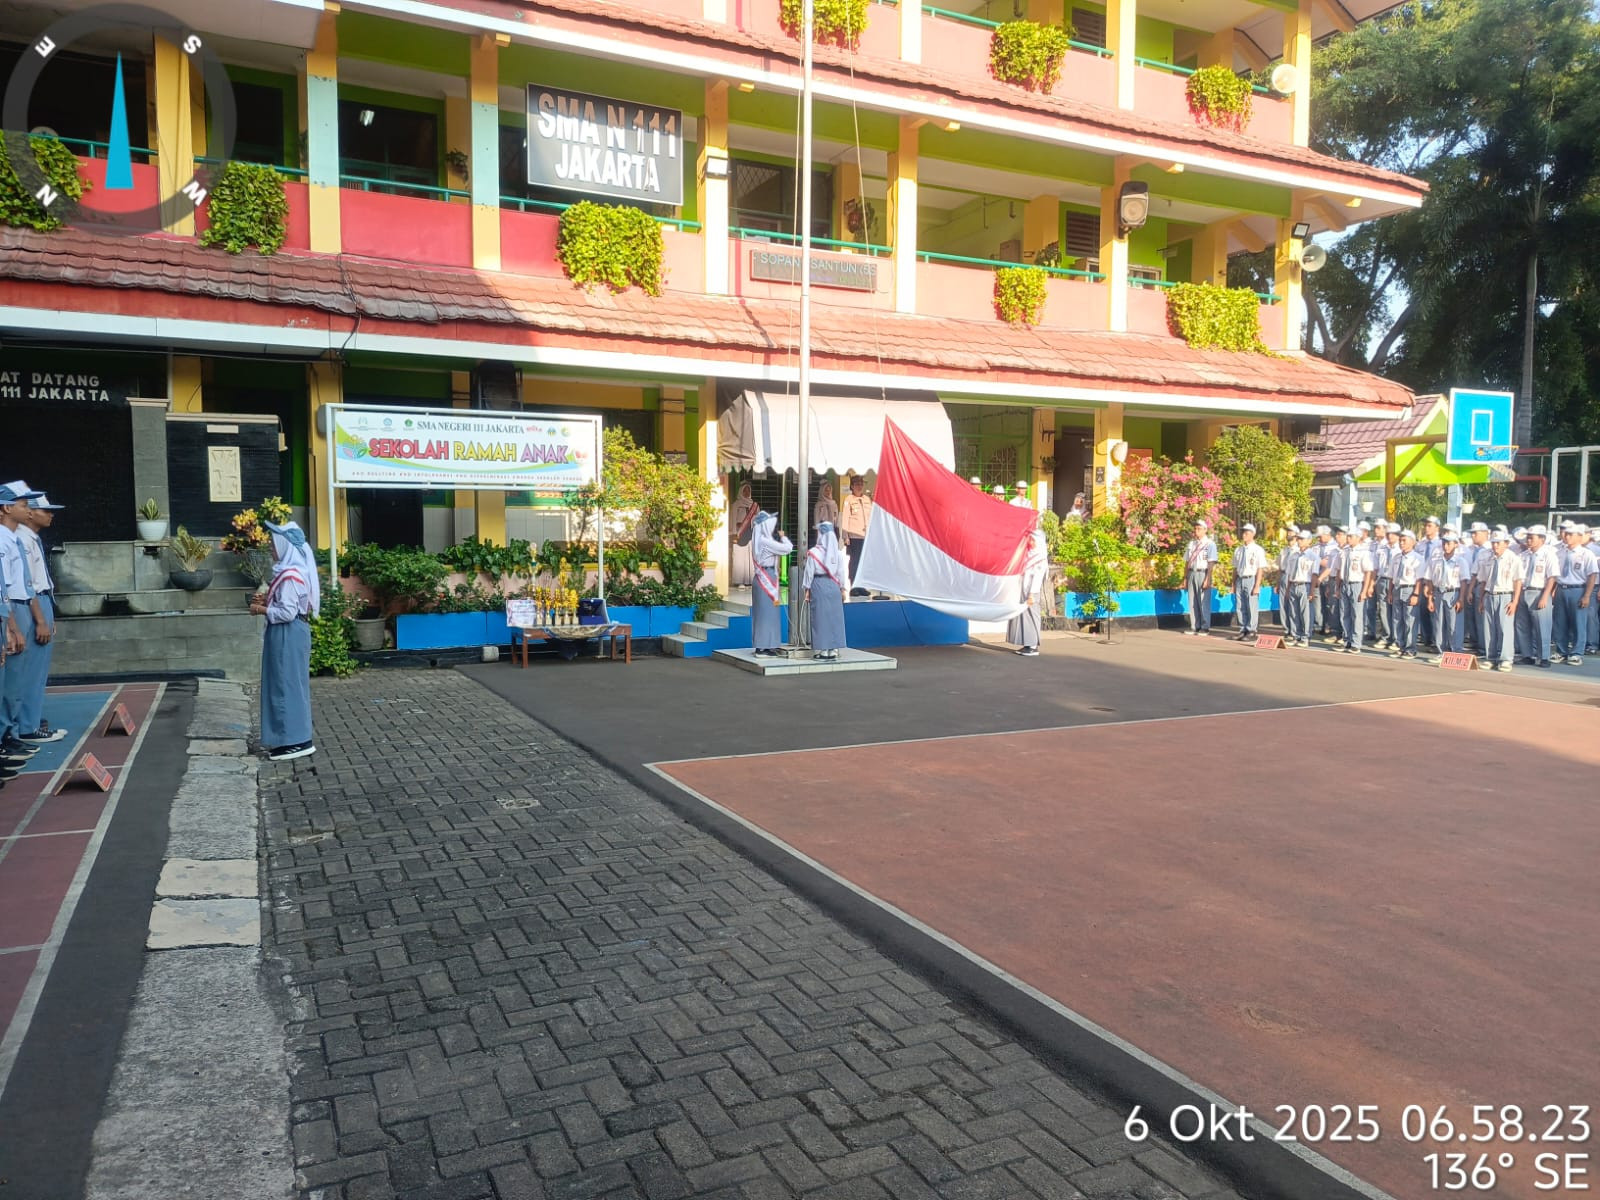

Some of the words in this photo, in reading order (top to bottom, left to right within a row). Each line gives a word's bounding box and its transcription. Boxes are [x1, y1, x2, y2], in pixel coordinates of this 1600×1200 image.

[538, 92, 600, 146] SMA
[607, 104, 627, 149] N
[632, 109, 676, 158] 111
[555, 143, 660, 193] JAKARTA
[760, 252, 801, 267] SOPAN
[811, 257, 857, 273] SANTUN
[31, 372, 100, 387] DATANG
[0, 385, 21, 398] 111
[28, 386, 110, 401] JAKARTA
[417, 421, 437, 431] SMA
[438, 421, 471, 432] NEGERI
[485, 423, 525, 434] JAKARTA
[368, 438, 449, 460] SEKOLAH
[453, 440, 517, 462] RAMAH
[520, 442, 569, 464] ANAK
